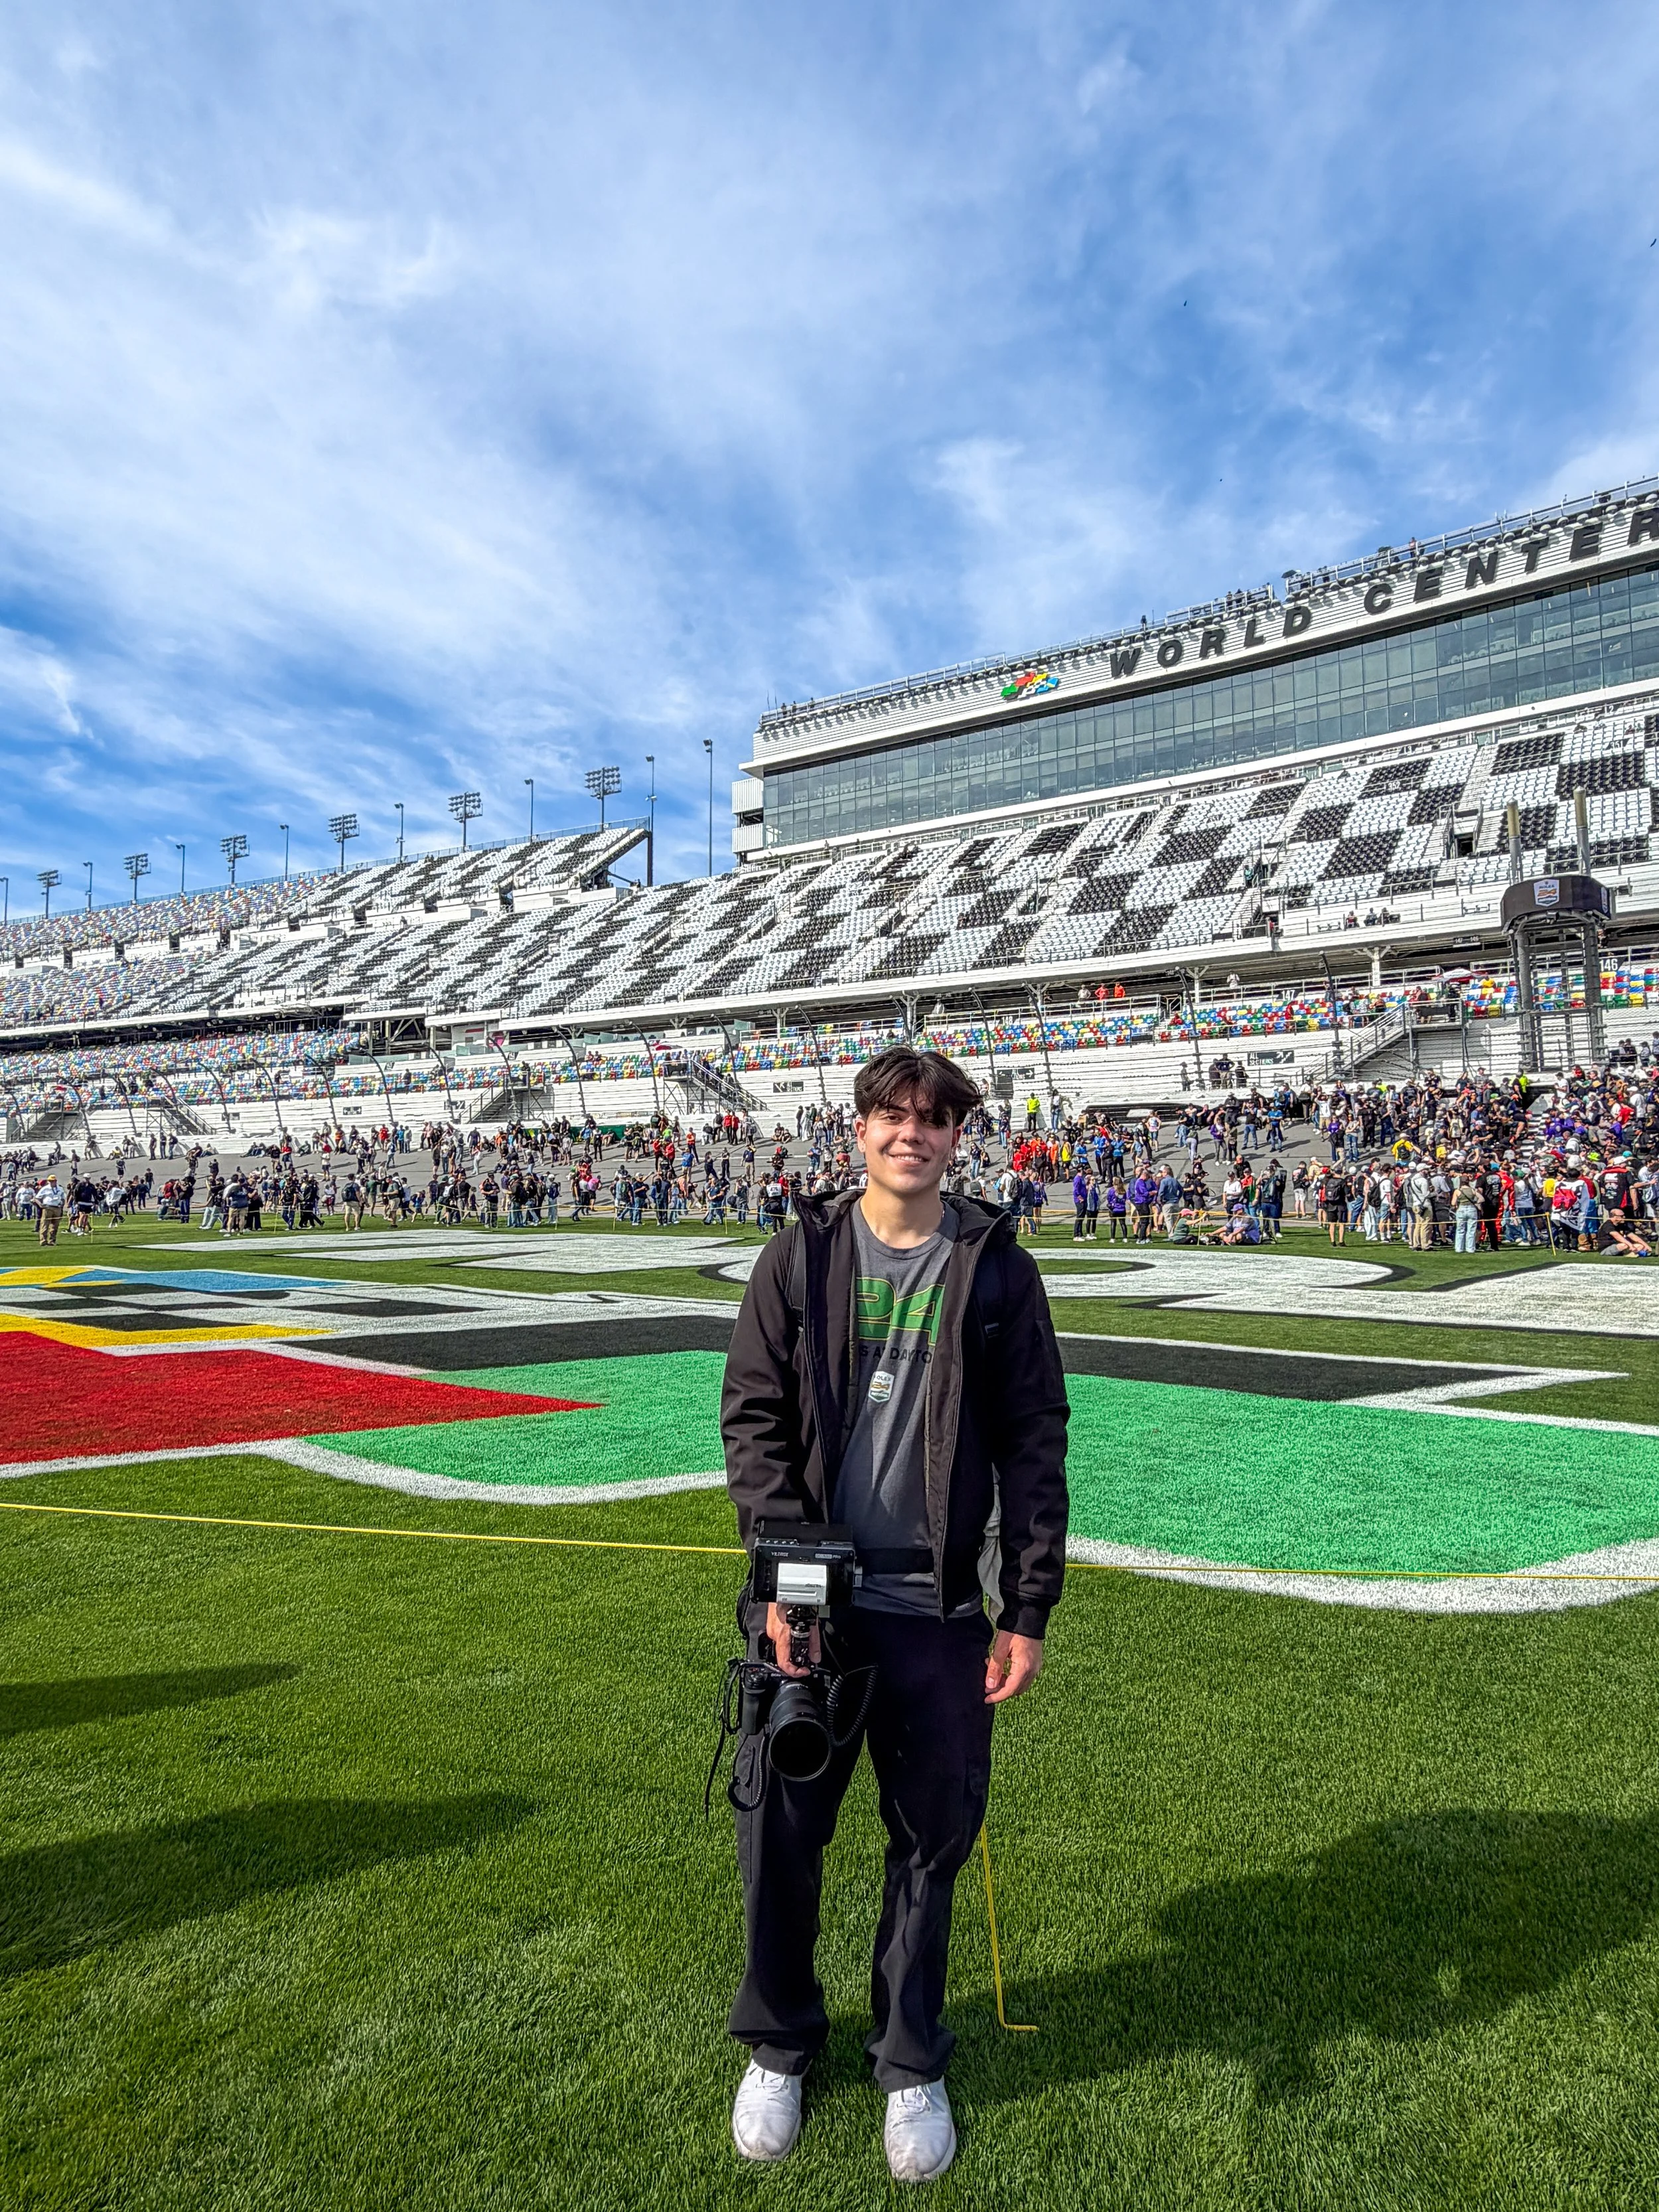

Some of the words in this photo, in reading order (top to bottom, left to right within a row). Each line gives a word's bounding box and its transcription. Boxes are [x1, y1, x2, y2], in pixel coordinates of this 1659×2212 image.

[1108, 605, 1312, 678] WORLD
[1363, 507, 1659, 615] CENTER
[1599, 958, 1618, 972] 146
[1281, 990, 1295, 1001] 147
[1001, 1016, 1013, 1025] 148
[856, 1277, 945, 1347] 24
[873, 1346, 885, 1359] A
